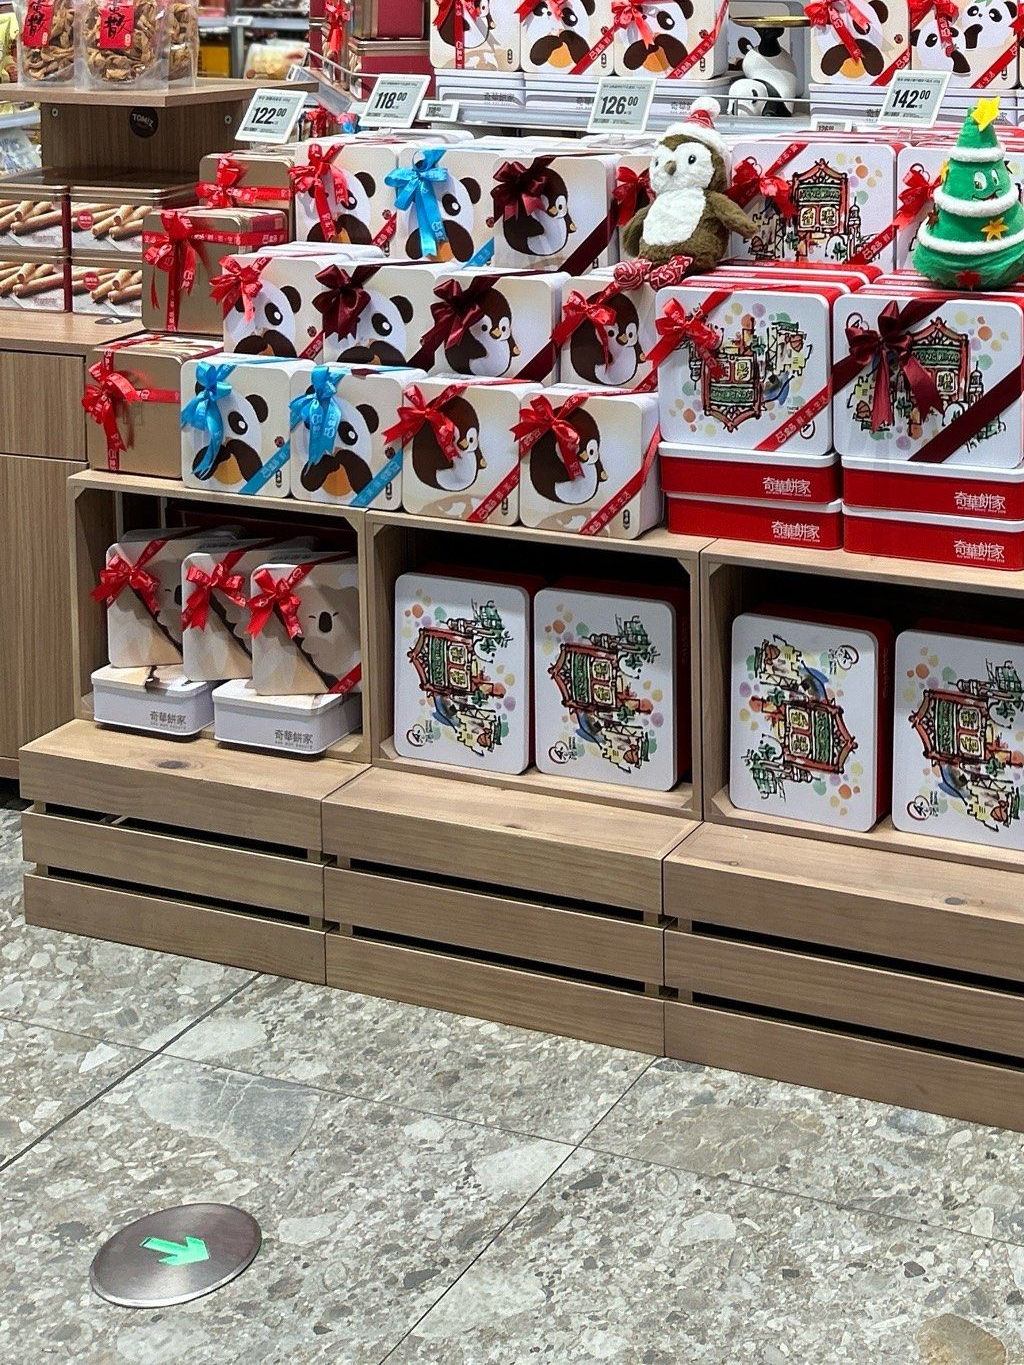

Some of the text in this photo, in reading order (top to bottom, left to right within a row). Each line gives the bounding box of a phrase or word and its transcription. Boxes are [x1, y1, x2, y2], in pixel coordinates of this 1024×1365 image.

[762, 476, 812, 494] 奇華餅家
[955, 491, 1006, 510] 奇華餅家
[771, 521, 820, 540] 奇華餅家
[953, 539, 1005, 560] 奇華餅家
